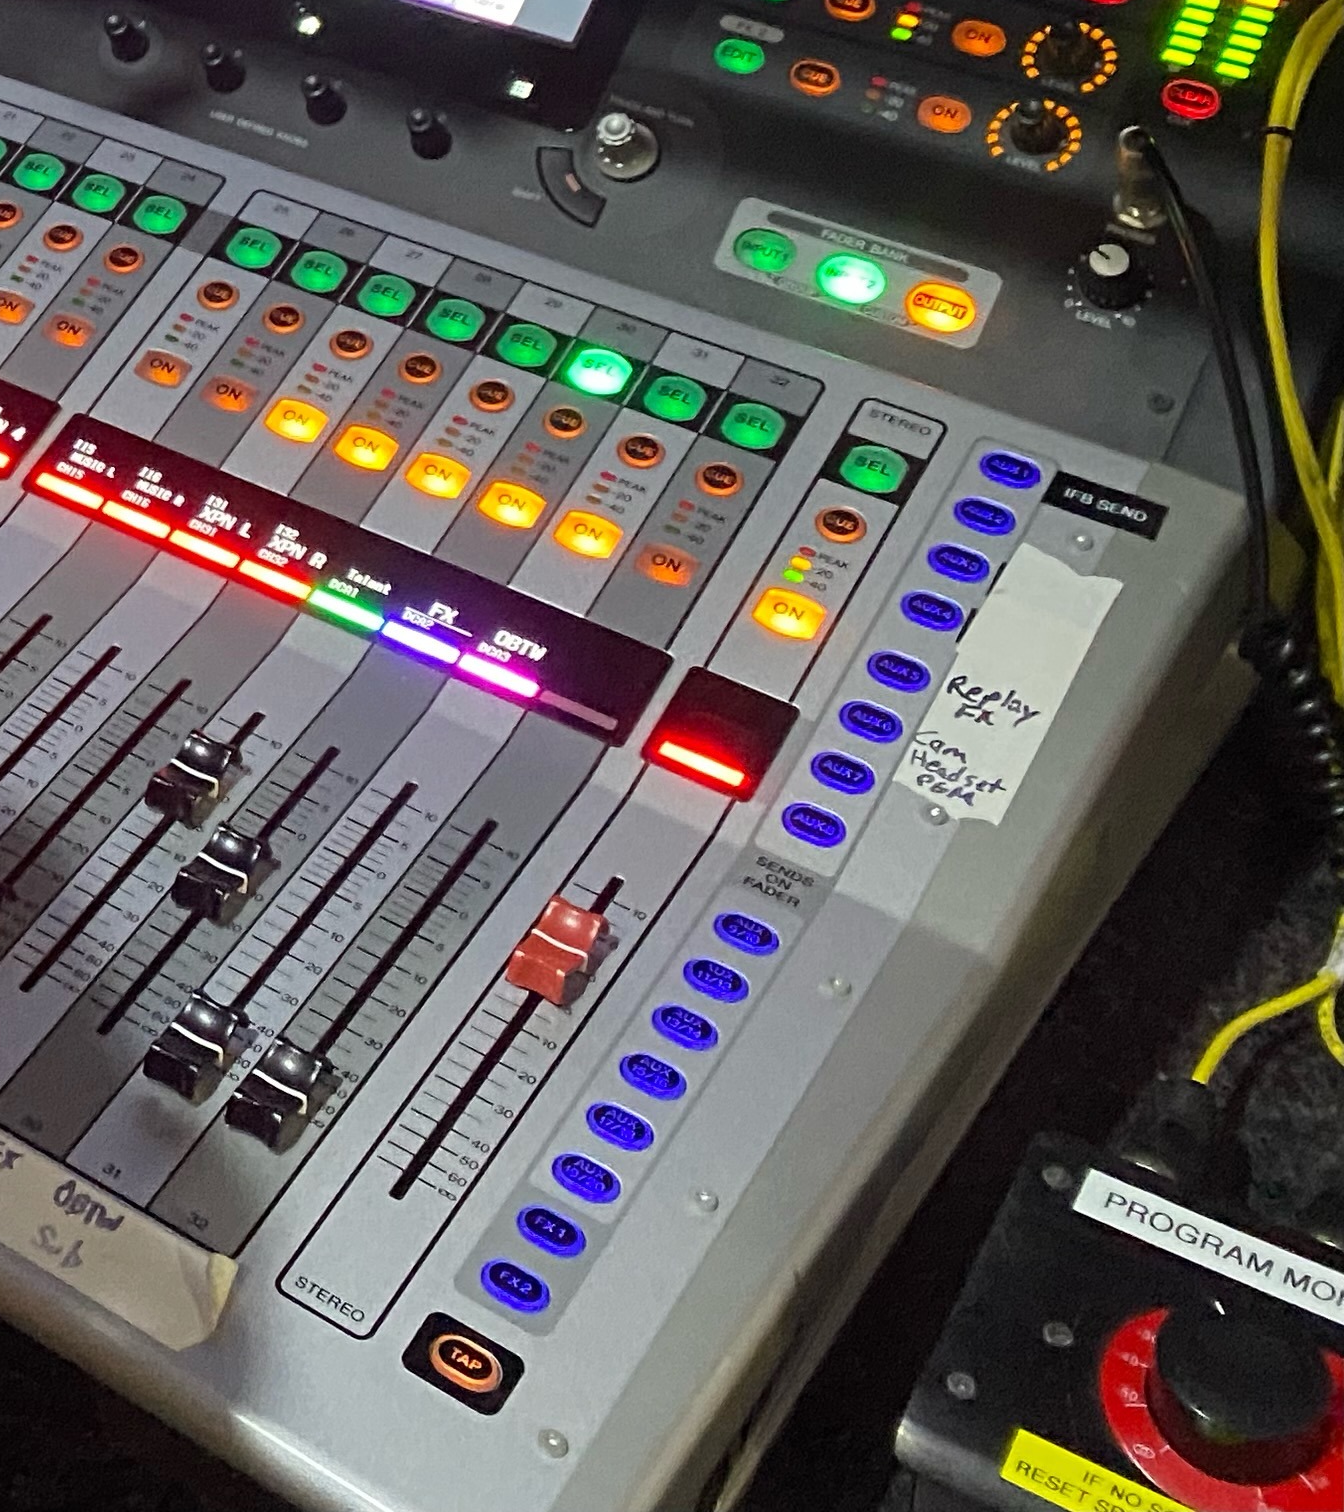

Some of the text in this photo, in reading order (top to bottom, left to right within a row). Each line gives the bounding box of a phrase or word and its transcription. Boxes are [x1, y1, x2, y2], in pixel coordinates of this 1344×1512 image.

[966, 29, 992, 44] ON
[933, 104, 959, 119] ON
[240, 236, 269, 253] SEL
[821, 228, 908, 263] FADER BANK
[304, 259, 334, 277] SEL
[370, 283, 401, 302] SEL
[913, 292, 967, 320] OUTPUT
[440, 307, 472, 327] SEL
[56, 320, 82, 336] ON
[511, 332, 542, 351] SEL
[150, 359, 176, 374] ON
[583, 358, 616, 377] SEL
[215, 384, 241, 400] ON
[659, 386, 692, 406] SEL
[283, 409, 309, 426] ON
[733, 412, 770, 433] SEL
[869, 408, 933, 437] STEREO
[10, 426, 27, 441] 4
[352, 437, 380, 453] ON
[423, 464, 453, 480] ON
[855, 456, 891, 474] SEL
[498, 494, 527, 510] ON
[1095, 496, 1149, 523] SEND
[197, 505, 252, 539] XPN L
[573, 522, 603, 541] ON
[265, 534, 329, 570] XPN R
[816, 552, 849, 570] PEAK
[651, 553, 683, 572] ON
[346, 567, 392, 596] Talent
[428, 601, 460, 626] FX
[773, 601, 806, 620] ON
[493, 629, 548, 662] OBTW
[946, 674, 1041, 728] Replay
[910, 750, 1008, 792] Headset
[756, 856, 814, 888] SENDS
[765, 873, 792, 890] ON
[743, 876, 801, 908] FADER
[633, 909, 647, 921] 10
[330, 931, 344, 943] 10
[280, 992, 299, 1006] 30
[388, 1004, 406, 1018] 20
[640, 1056, 673, 1077] AUX
[517, 1070, 537, 1085] 20
[493, 1104, 514, 1119] 30
[605, 1108, 640, 1129] AUX
[472, 1139, 490, 1154] 40
[458, 1155, 479, 1171] 50
[575, 1159, 606, 1180] AUX
[448, 1171, 467, 1187] 60
[534, 1216, 554, 1233] FX
[1103, 1189, 1275, 1279] PROGRAM
[499, 1271, 532, 1295] FX 2
[294, 1275, 366, 1324] STEREO
[450, 1346, 482, 1371] TAP
[1015, 1460, 1090, 1503] RESET
[1082, 1470, 1142, 1507] IF NO
